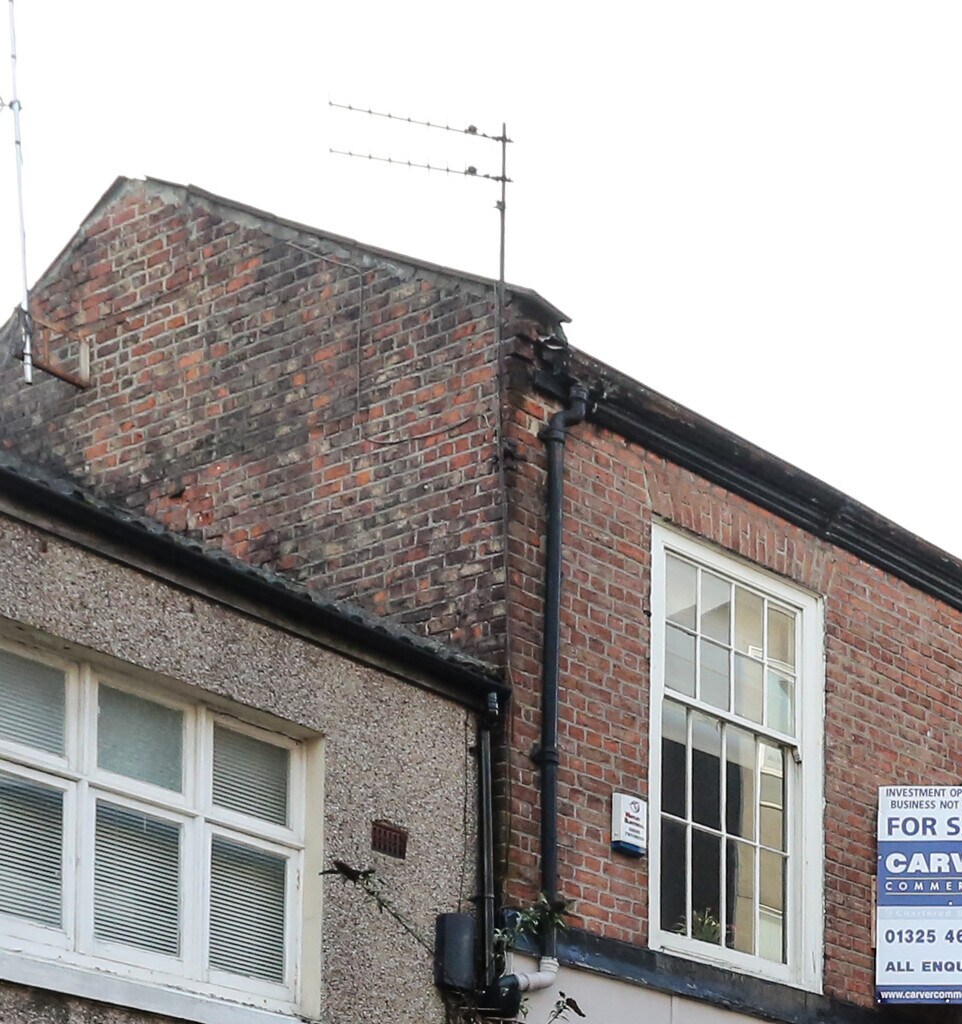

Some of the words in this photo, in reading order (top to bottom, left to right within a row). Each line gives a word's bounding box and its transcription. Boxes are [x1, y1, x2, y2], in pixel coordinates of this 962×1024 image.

[885, 788, 946, 798] INVESTMENT
[890, 800, 936, 809] BUSINESS
[940, 800, 959, 809] NOT
[887, 816, 937, 836] FOR
[885, 929, 936, 943] 01325
[885, 961, 914, 972] ALL
